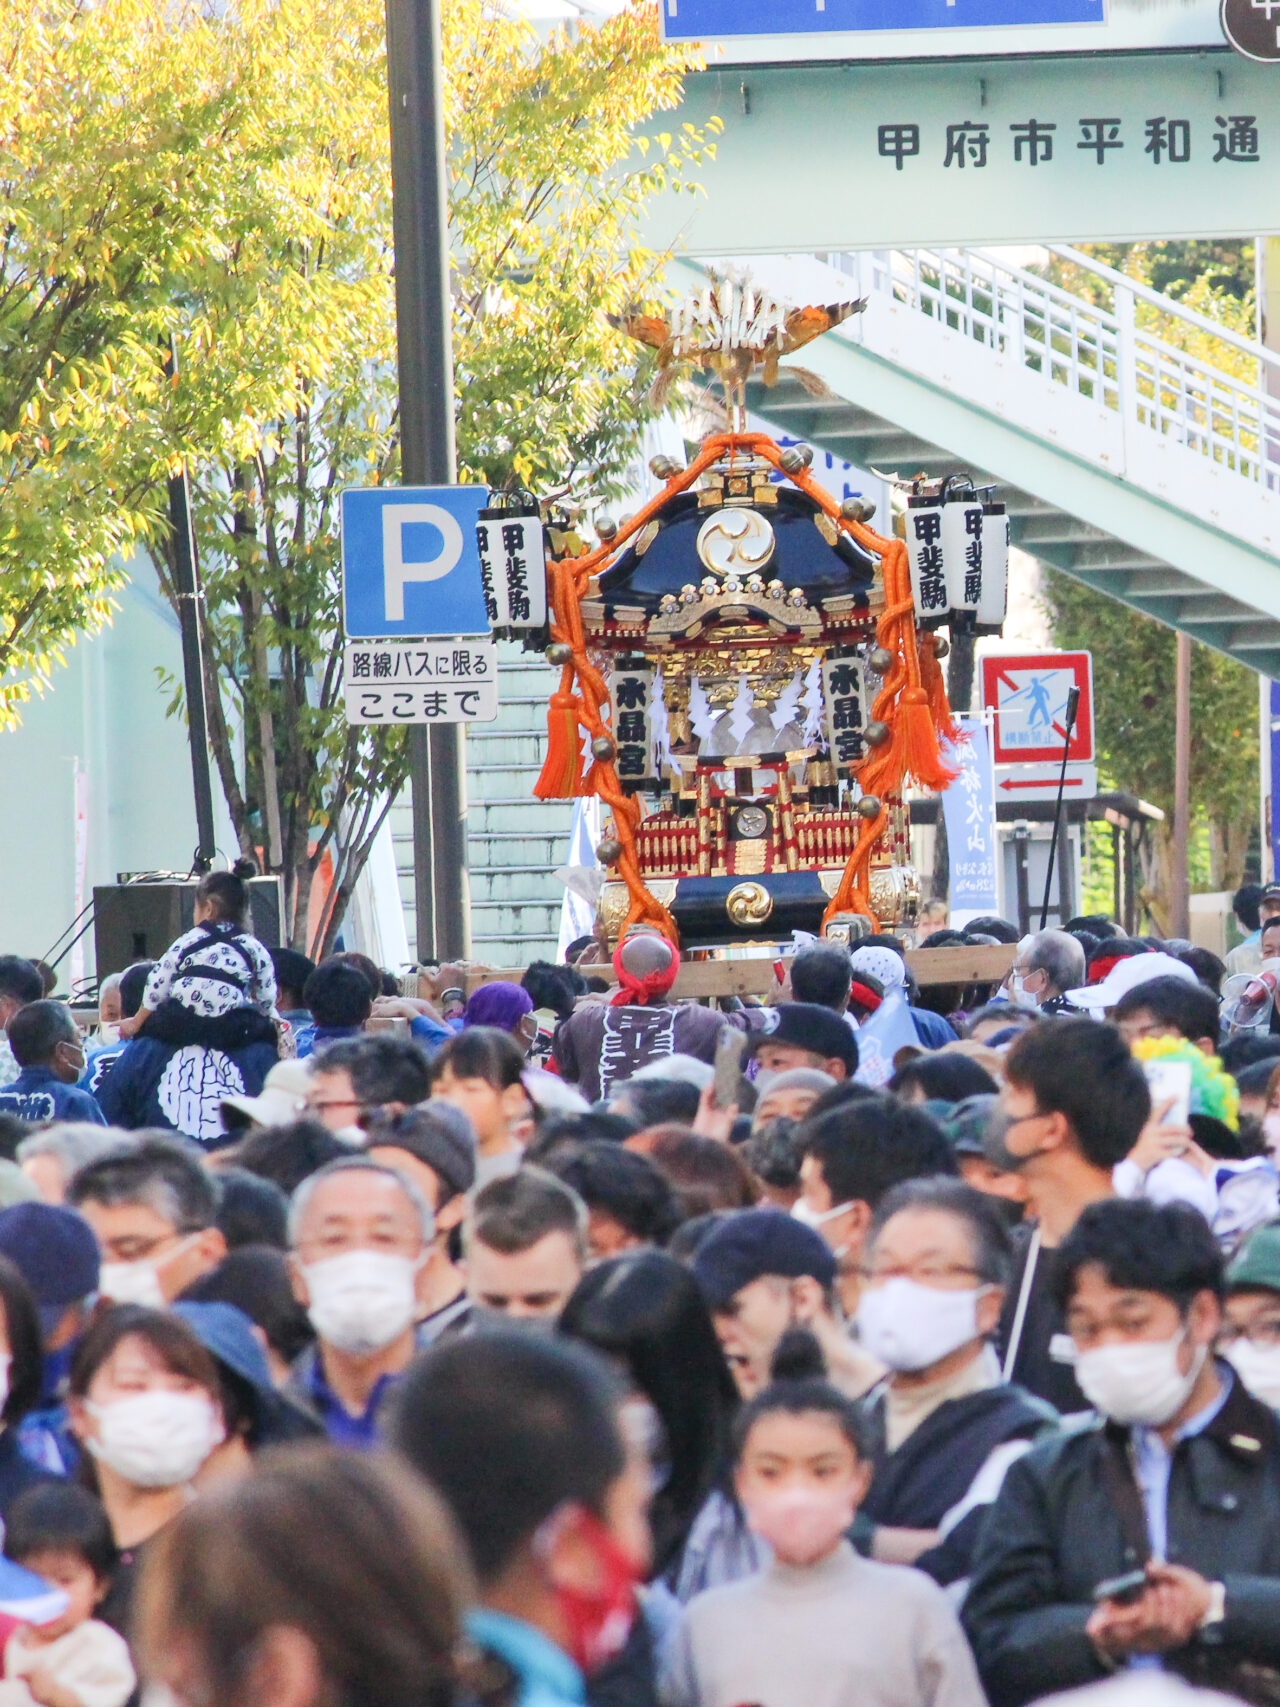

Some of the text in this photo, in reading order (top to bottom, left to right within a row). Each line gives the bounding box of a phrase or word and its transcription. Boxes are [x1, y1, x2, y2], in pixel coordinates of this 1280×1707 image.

[382, 503, 464, 621] P
[352, 651, 488, 678] 路線バスに限る
[360, 690, 481, 718] ここまで
[616, 676, 646, 776] 水晶宮
